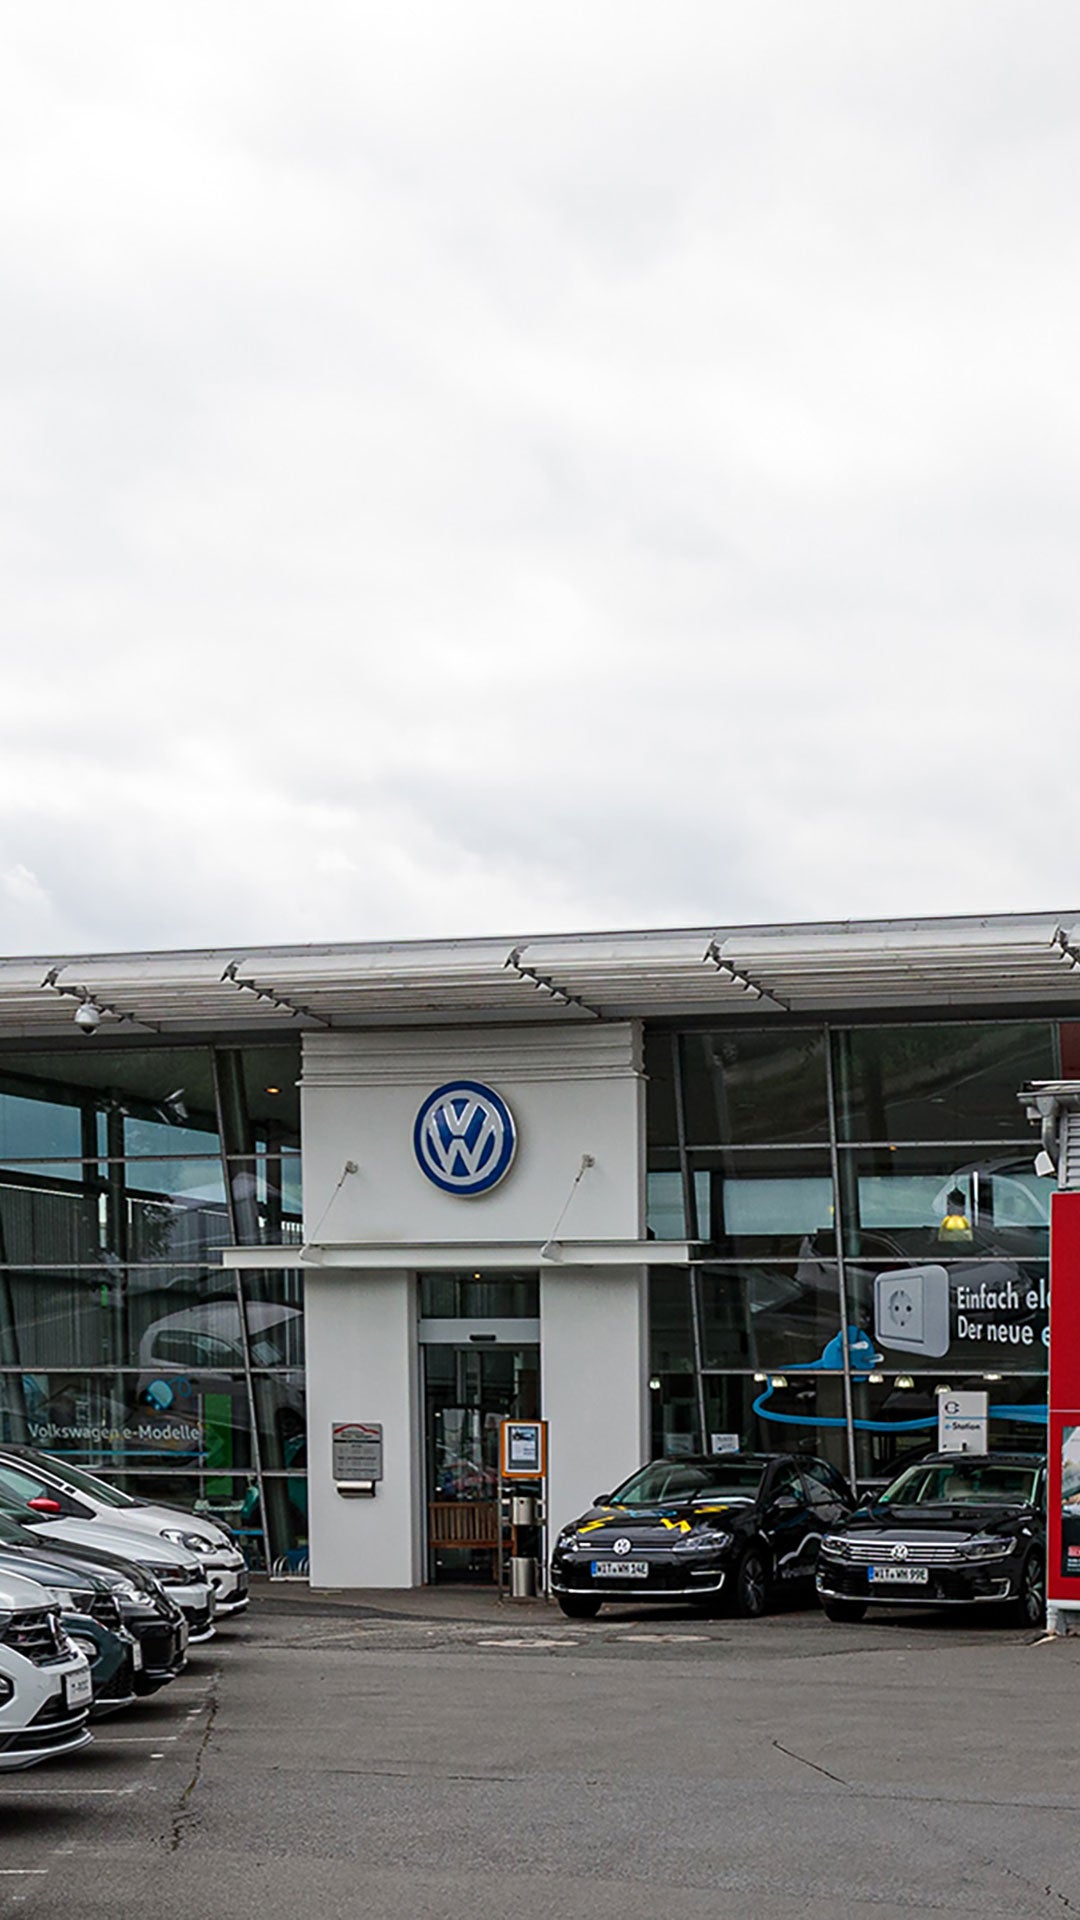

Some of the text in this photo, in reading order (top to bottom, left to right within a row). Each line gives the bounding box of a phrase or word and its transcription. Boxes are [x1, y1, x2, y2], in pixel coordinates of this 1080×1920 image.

[422, 1090, 504, 1184] VW
[957, 1278, 1050, 1310] Einfach el
[958, 1315, 983, 1340] Der
[987, 1324, 1034, 1345] neue
[27, 1423, 200, 1442] Volkswagen e-Modelle
